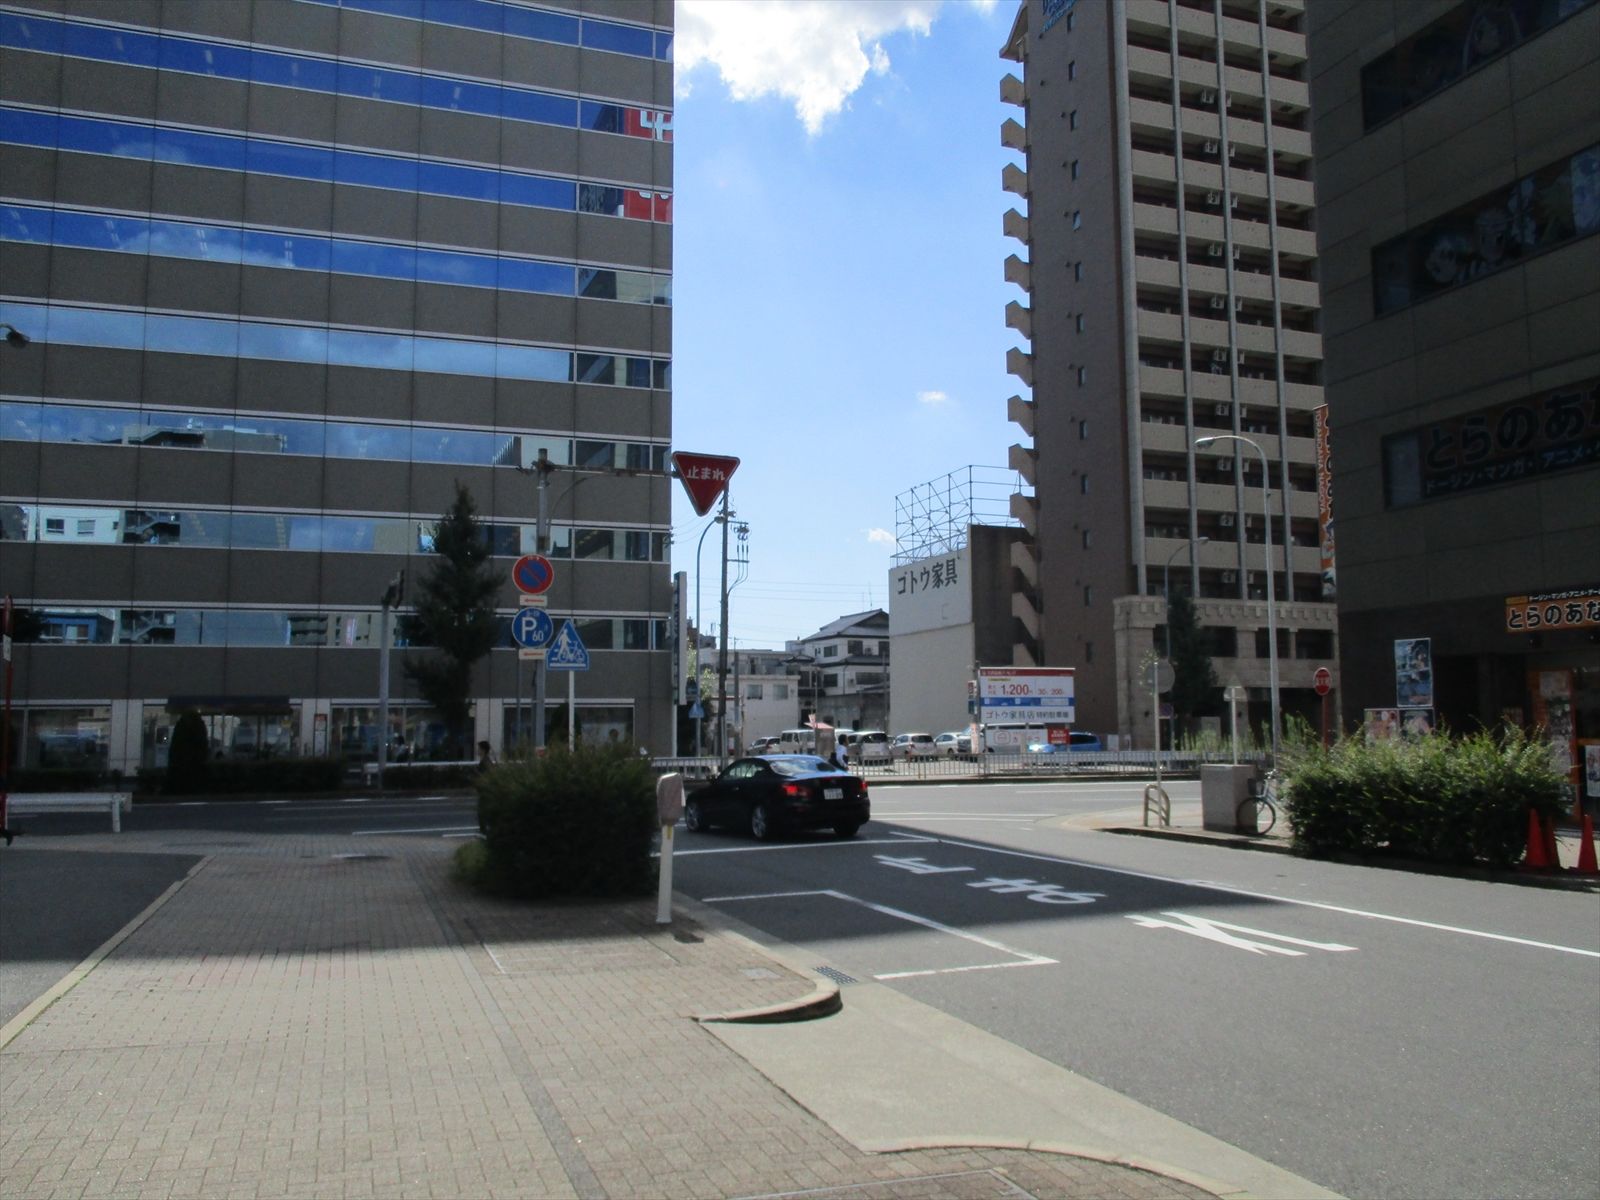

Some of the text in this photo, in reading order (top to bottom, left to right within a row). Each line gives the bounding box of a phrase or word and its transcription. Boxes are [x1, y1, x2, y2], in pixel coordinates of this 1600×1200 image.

[686, 465, 726, 481] 止まれ
[897, 558, 958, 595] ゴトウ家具
[1507, 600, 1600, 630] とらのあな
[522, 616, 544, 643] P 60
